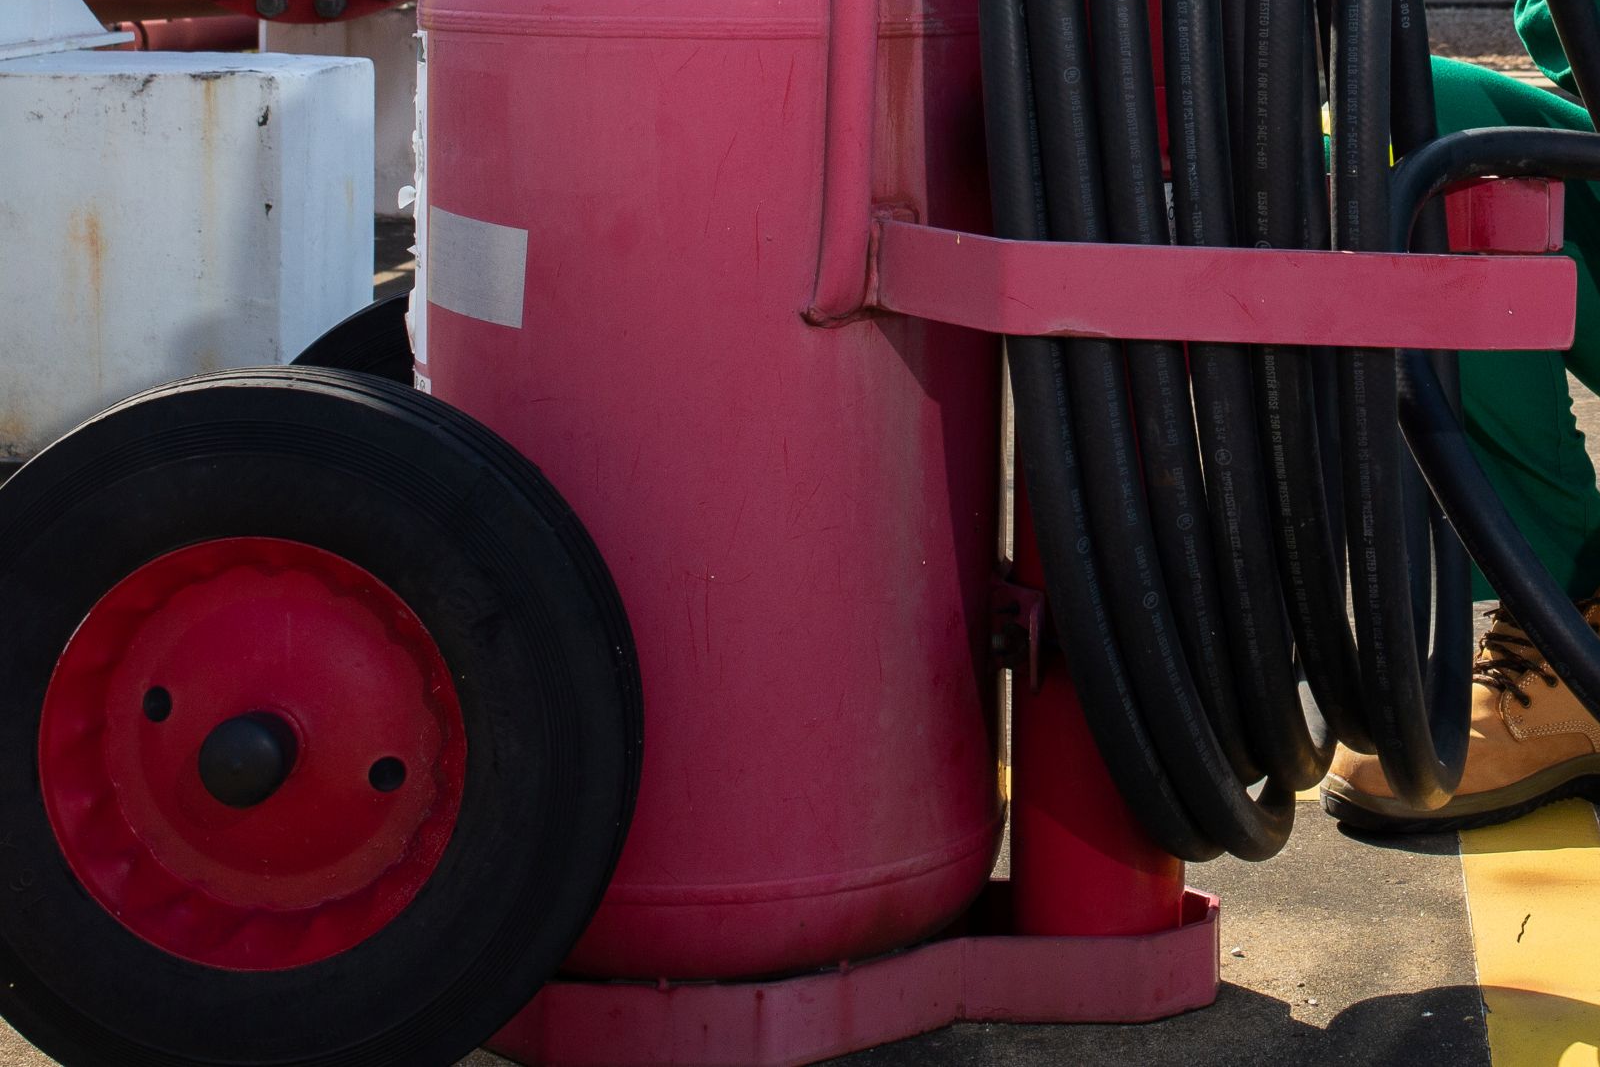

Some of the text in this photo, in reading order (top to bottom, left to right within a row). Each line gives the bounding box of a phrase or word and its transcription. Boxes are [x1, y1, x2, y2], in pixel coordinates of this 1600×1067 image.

[1348, 4, 1359, 31] TESTED
[1399, 3, 1409, 15] 08
[1400, 15, 1410, 29] 03
[1259, 28, 1270, 37] TO
[1348, 34, 1358, 44] TO
[1119, 30, 1131, 56] LISTED
[1178, 26, 1190, 62] BOOSTER
[1259, 40, 1270, 56] 500
[1348, 47, 1358, 63] 500
[1121, 58, 1133, 76] FIRE
[1179, 64, 1191, 85] HOSE
[1258, 73, 1268, 88] FOR
[1348, 80, 1358, 95] FOR
[1181, 90, 1193, 105] 250
[1257, 90, 1268, 106] USE
[1348, 98, 1358, 112] USE
[1125, 102, 1139, 137] BOOSTER
[1183, 108, 1195, 120] PSI
[1257, 109, 1268, 118] AT
[1348, 115, 1358, 125] AT
[1184, 122, 1197, 160] WORKING
[1071, 113, 1084, 138] LISTED
[1079, 183, 1094, 216] BOOSTER
[1187, 162, 1200, 201] PRESSURE
[1257, 191, 1268, 215] EX589
[1191, 212, 1202, 238] TESTED
[1263, 355, 1277, 388] BOOSTER
[1267, 390, 1279, 410] HOSE
[1269, 414, 1281, 430] 250
[1273, 445, 1287, 479] WORKING
[1359, 463, 1371, 498] WORKING
[1277, 481, 1292, 516] PRESSURE
[1283, 525, 1297, 549] TESTED
[1287, 551, 1299, 560] TO
